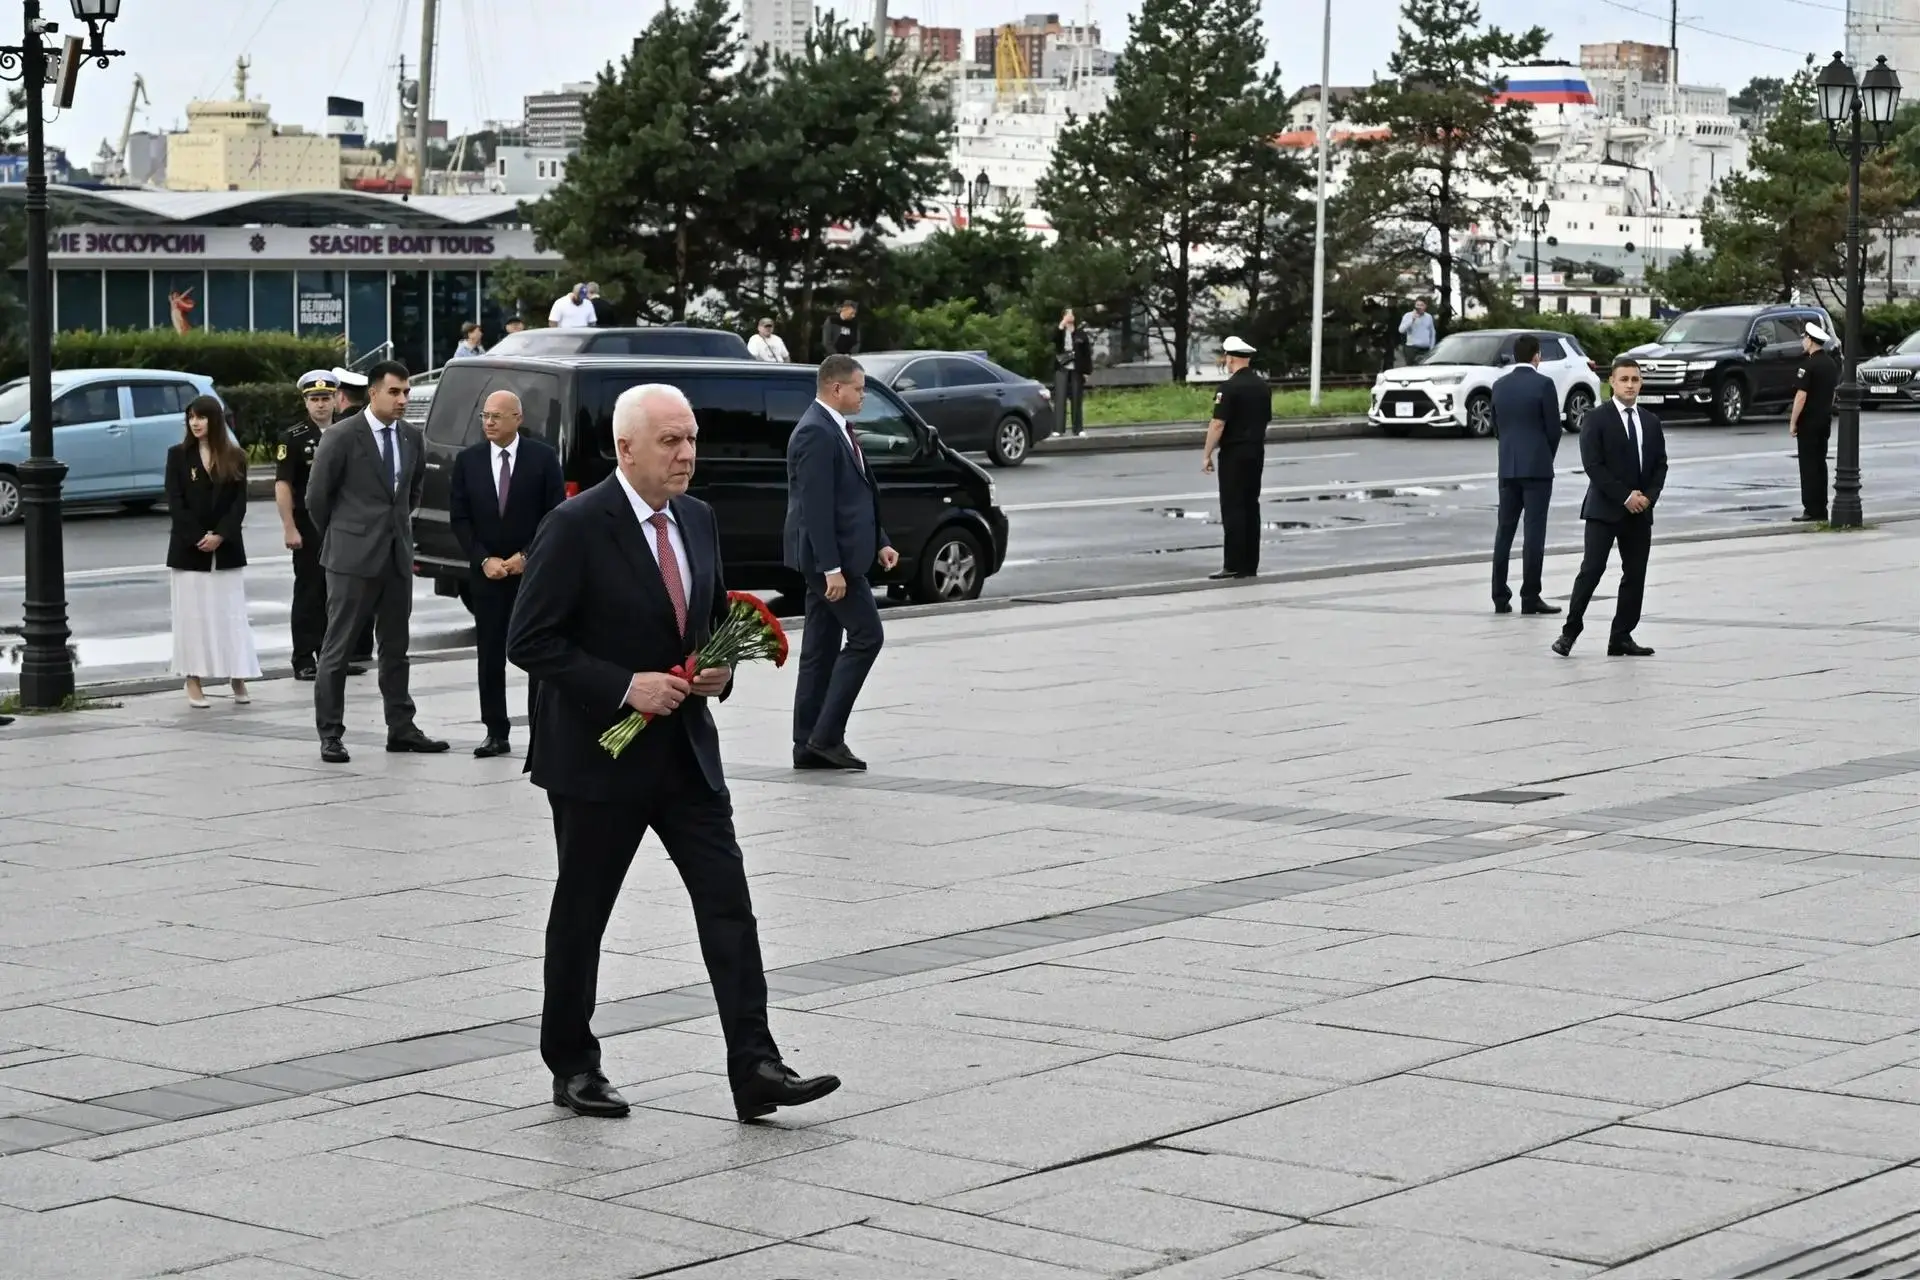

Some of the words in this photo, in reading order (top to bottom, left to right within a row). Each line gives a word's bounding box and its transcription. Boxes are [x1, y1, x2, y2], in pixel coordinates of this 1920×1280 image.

[86, 233, 205, 252] ЭКСКУРСИИ
[309, 236, 384, 254] SEASIDE
[388, 236, 434, 254] BOAT
[437, 236, 495, 254] TOURS
